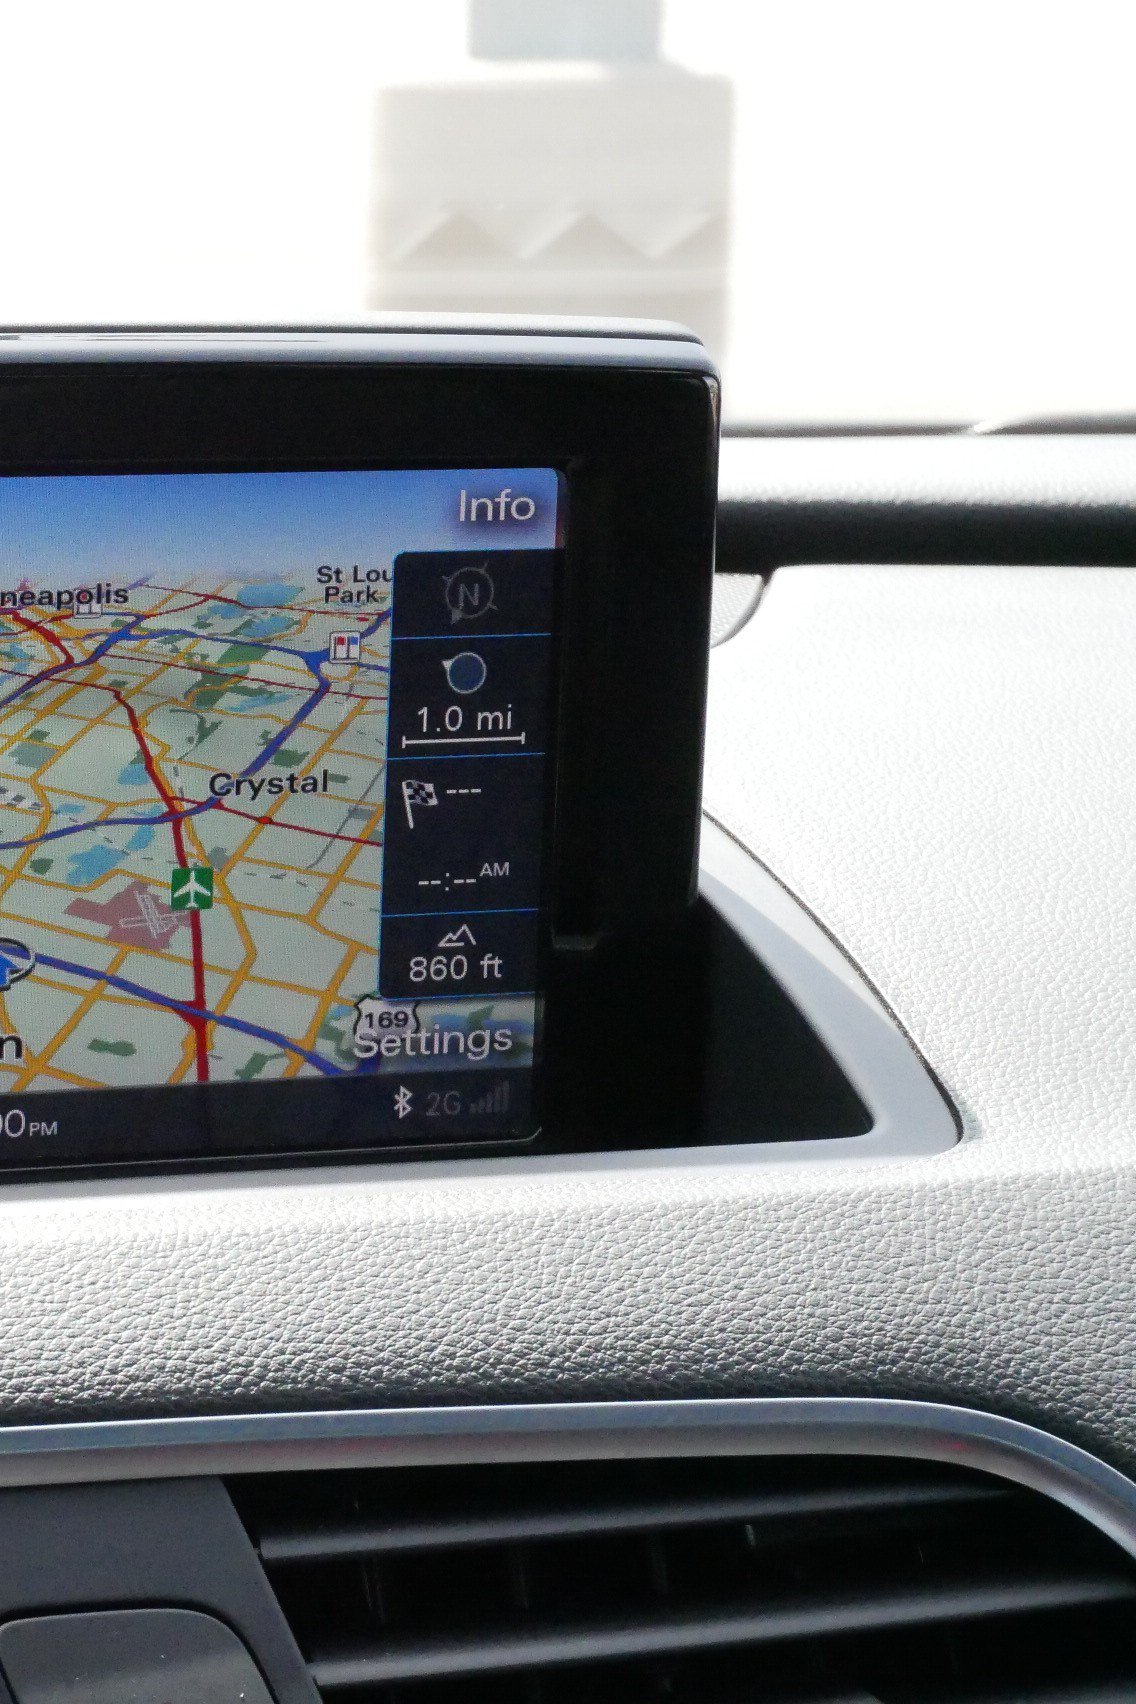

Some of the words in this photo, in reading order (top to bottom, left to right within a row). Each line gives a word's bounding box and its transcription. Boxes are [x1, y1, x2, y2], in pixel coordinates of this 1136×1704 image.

[459, 489, 536, 522] Info
[317, 565, 343, 583] St
[325, 585, 380, 604] Park
[417, 705, 462, 732] 1.0
[476, 704, 512, 730] mi
[209, 769, 328, 800] Crystal
[409, 955, 468, 982] 860
[480, 953, 503, 979] ft
[364, 1011, 409, 1029] 169
[354, 1024, 513, 1060] Settings
